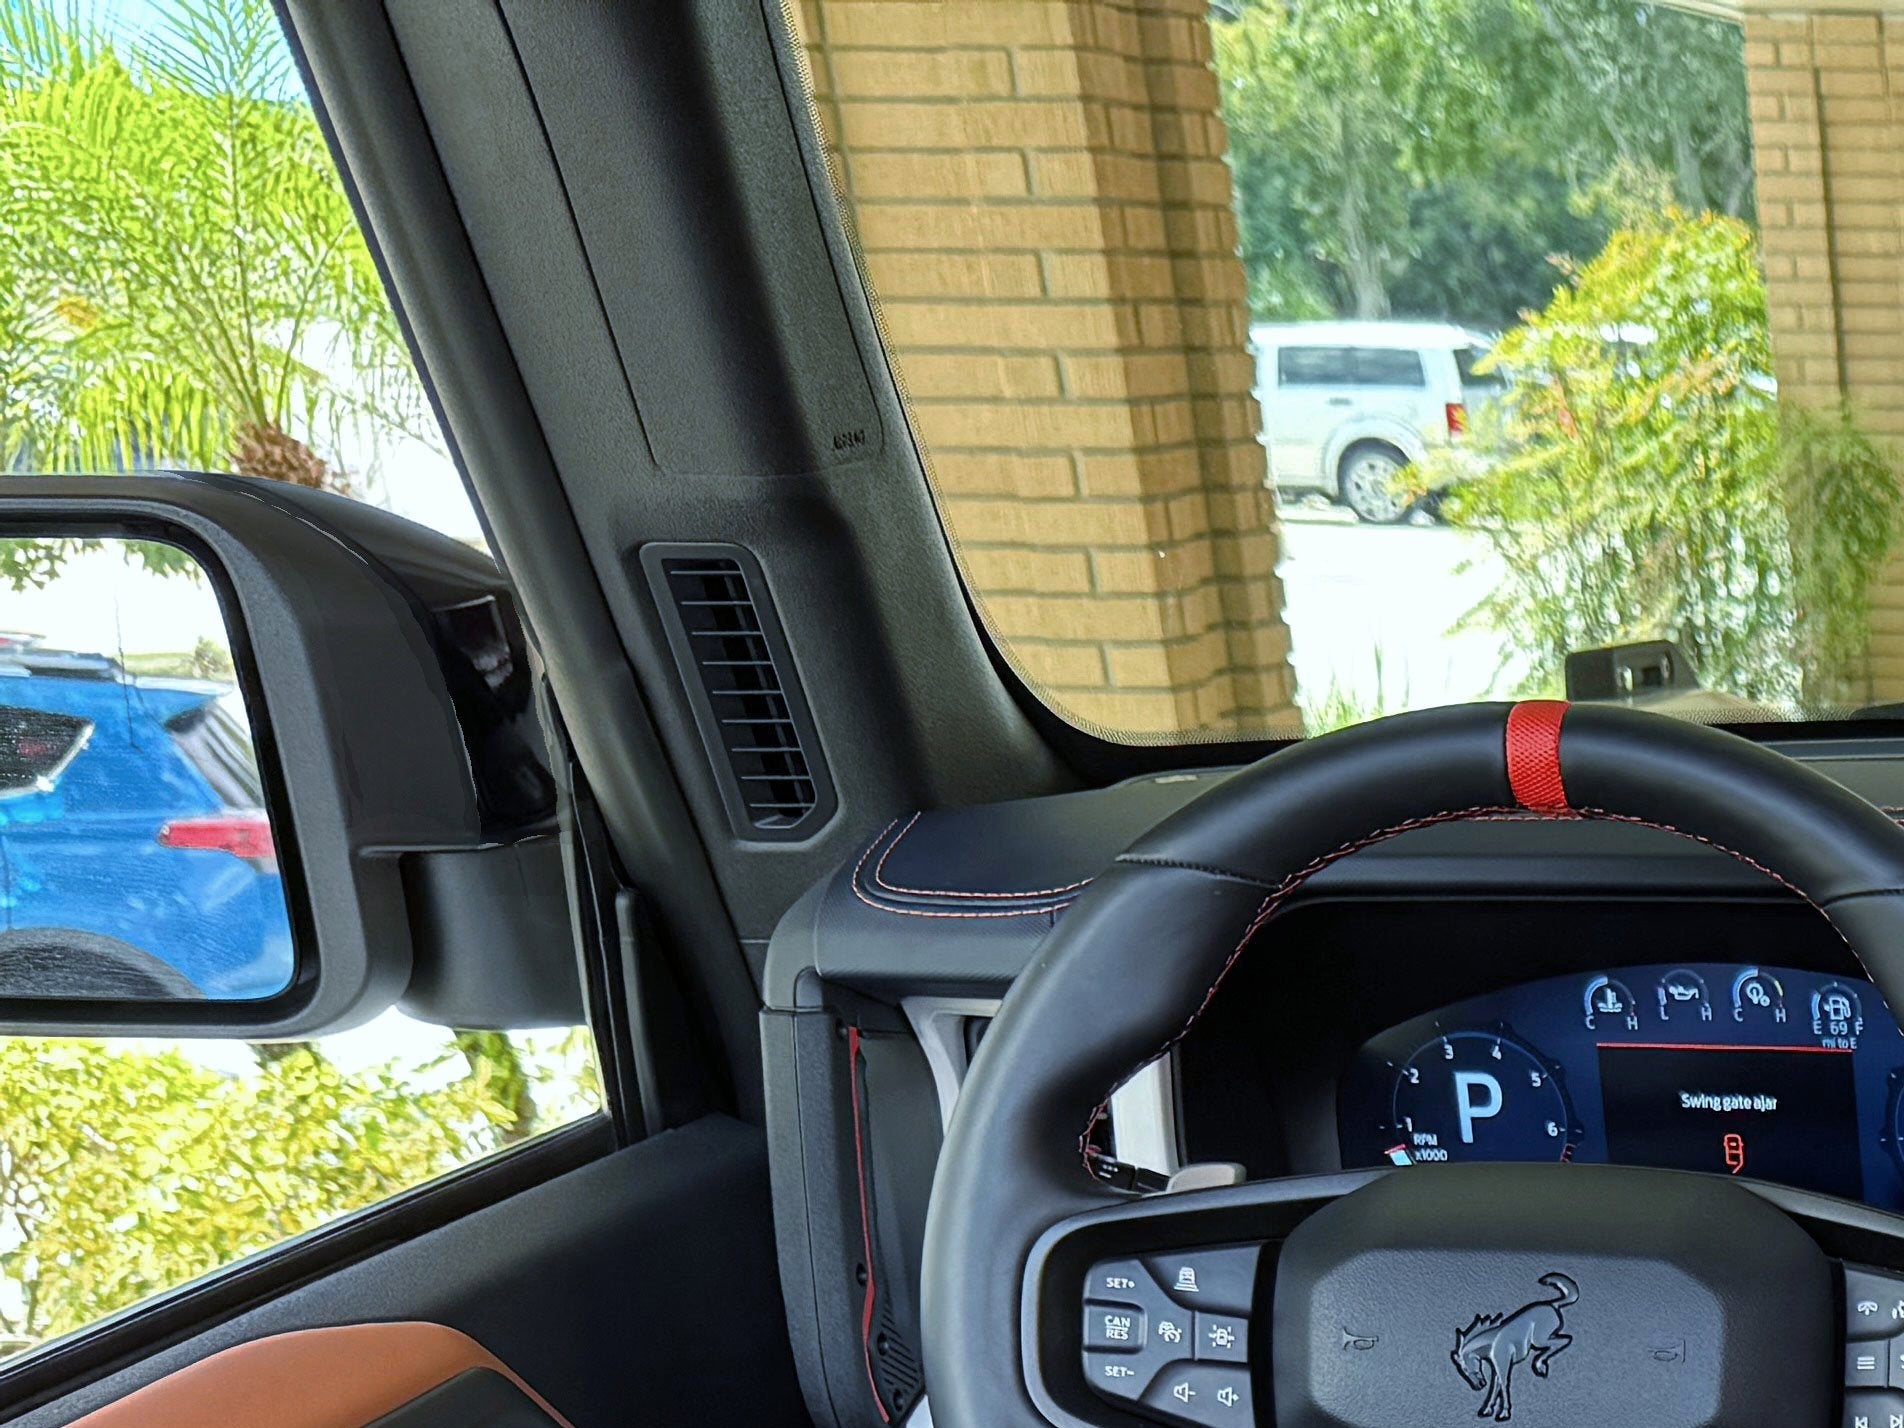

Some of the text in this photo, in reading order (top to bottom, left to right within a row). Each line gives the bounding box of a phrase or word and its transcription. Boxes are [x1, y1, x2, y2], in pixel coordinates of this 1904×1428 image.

[1660, 1007, 1670, 1021] L
[1701, 1006, 1713, 1021] H
[1733, 1008, 1744, 1022] C
[1775, 1008, 1787, 1023] H
[1585, 1016, 1596, 1030] C
[1627, 1016, 1639, 1031] H
[1813, 1021, 1864, 1036] E 69 F
[1838, 1038, 1849, 1050] to
[1850, 1038, 1857, 1050] E
[1444, 1045, 1454, 1060] 3
[1492, 1045, 1502, 1060] 4
[1409, 1069, 1420, 1084] 2
[1531, 1071, 1542, 1087] 5
[1454, 1071, 1503, 1144] P
[1680, 1093, 1778, 1112] Swing gate ajar
[1404, 1116, 1413, 1132] 1
[1546, 1121, 1558, 1137] 6
[1413, 1134, 1438, 1146] RPM
[1104, 1315, 1131, 1328] CAN
[1105, 1328, 1129, 1340] RES
